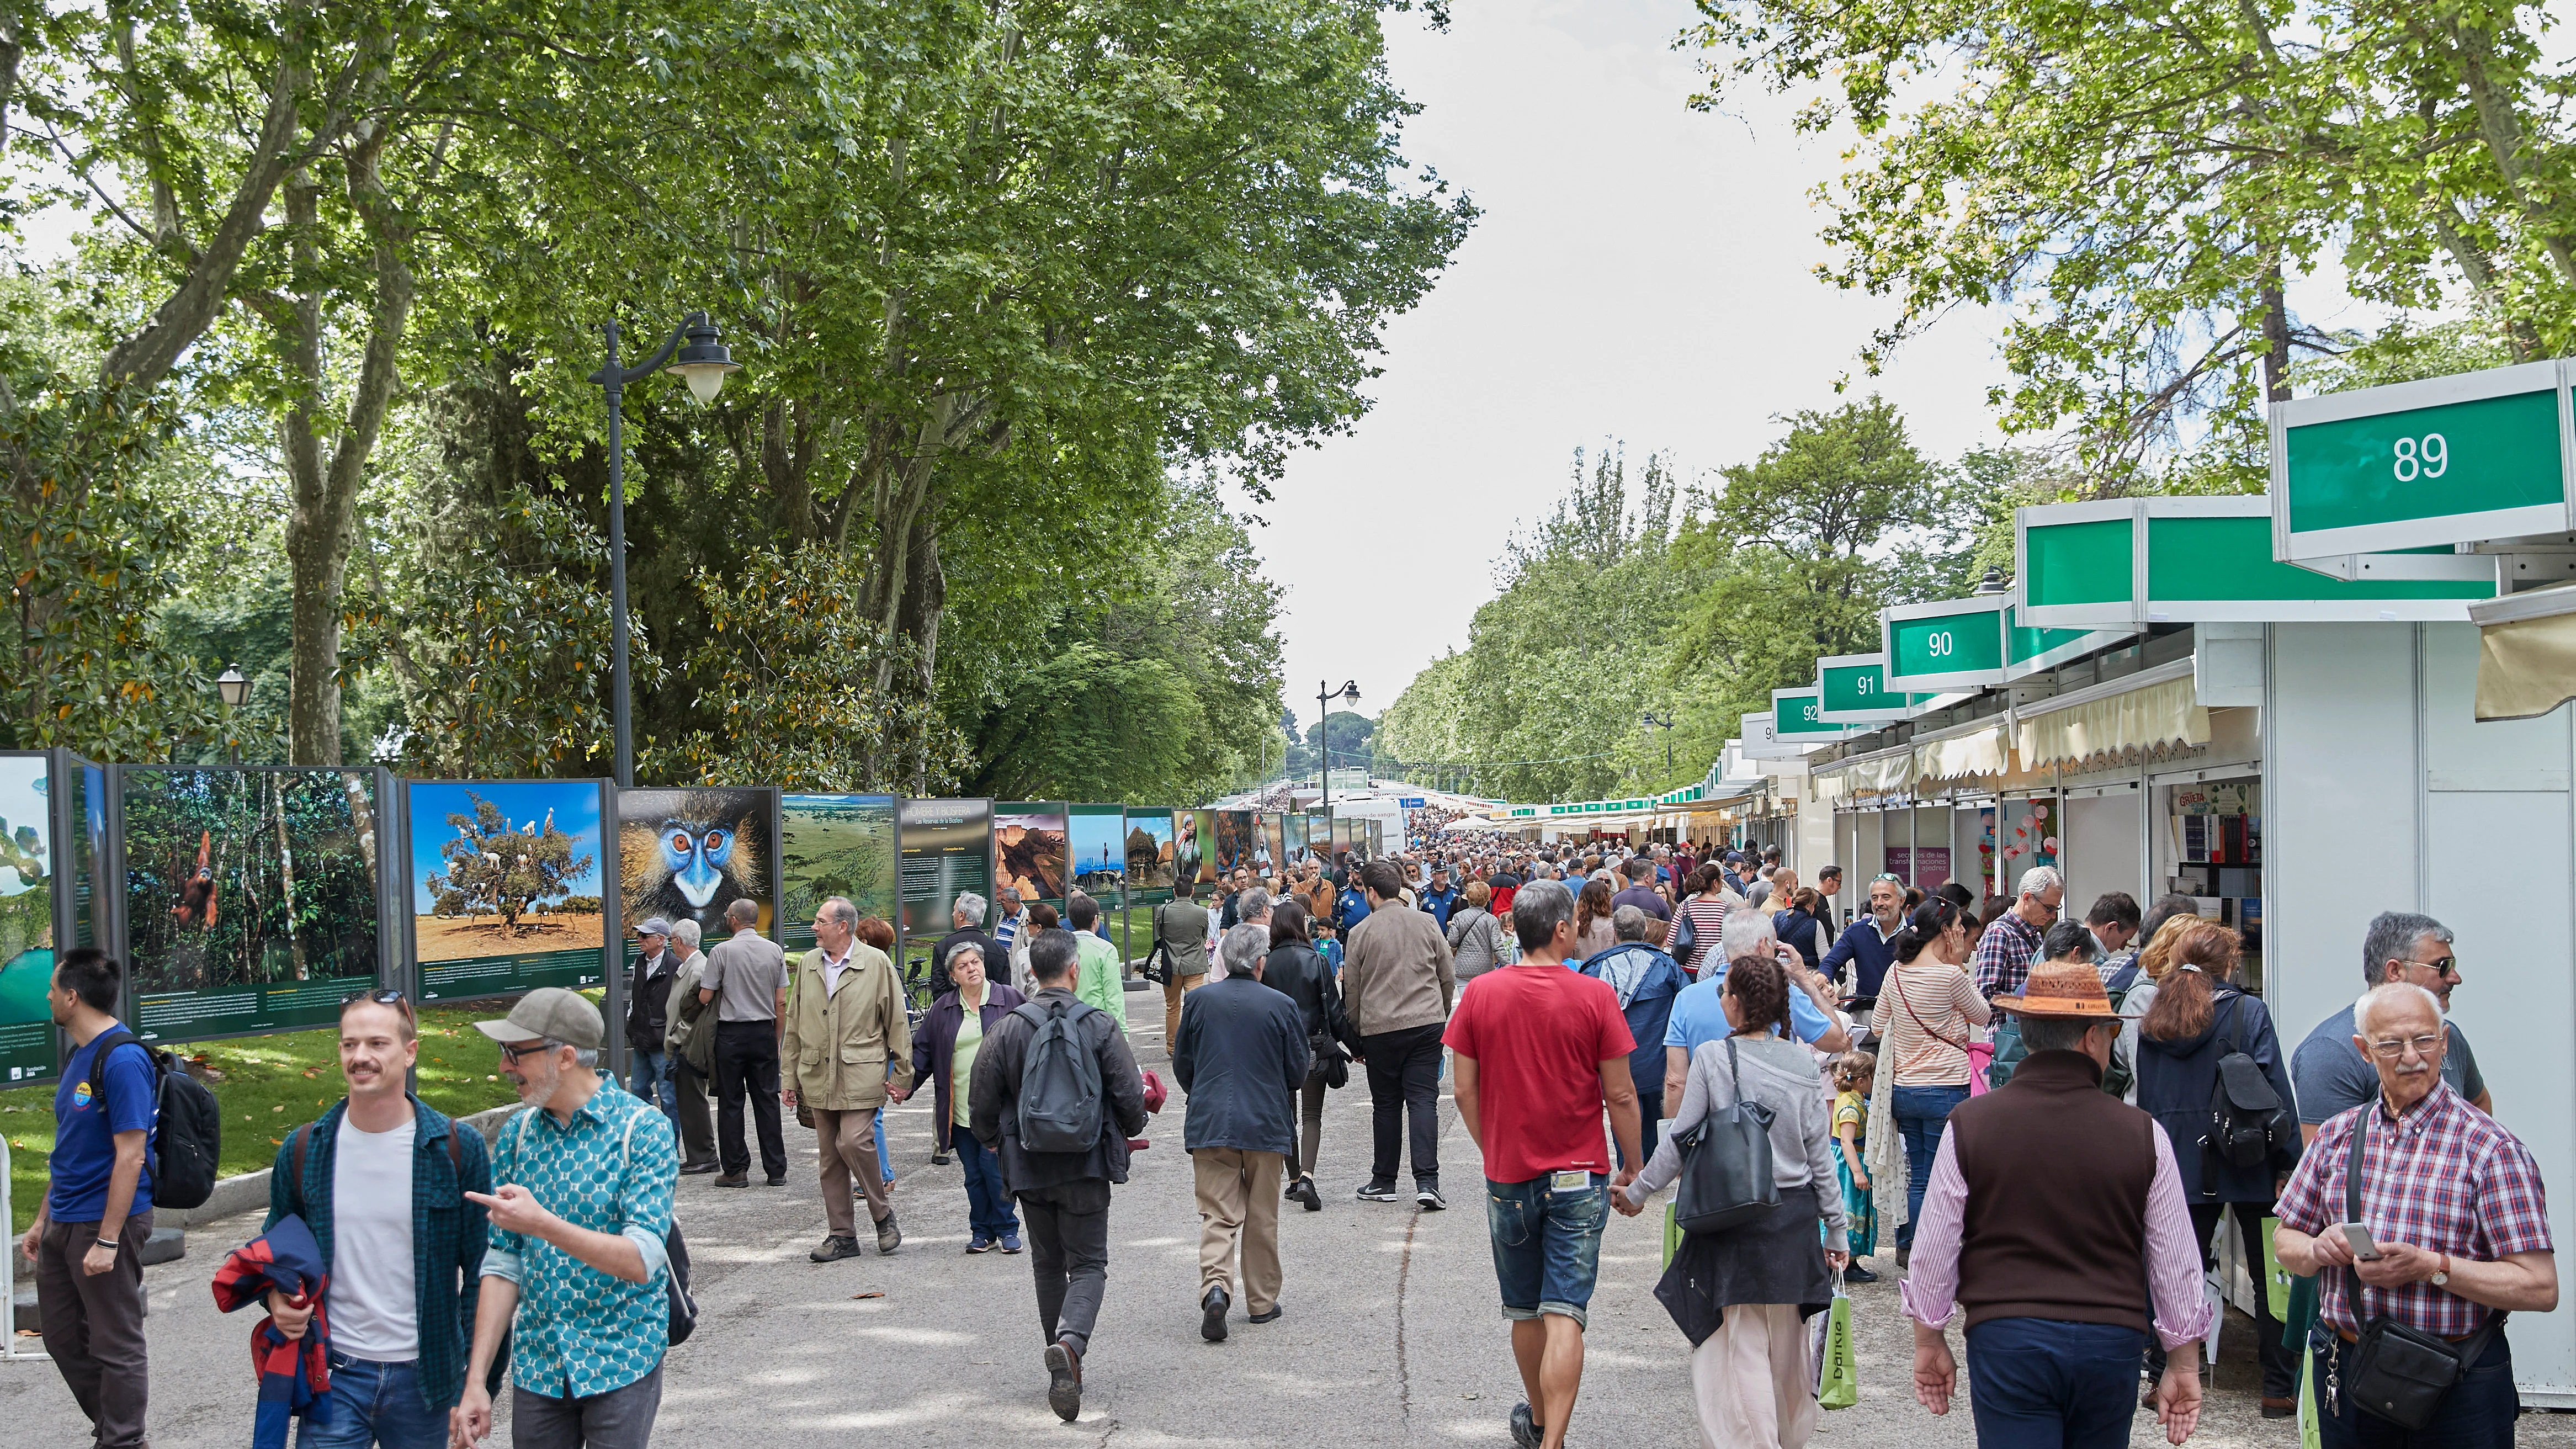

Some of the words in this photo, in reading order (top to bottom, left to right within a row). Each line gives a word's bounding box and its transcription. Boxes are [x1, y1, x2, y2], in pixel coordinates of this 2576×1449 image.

[2393, 433, 2448, 482] 89
[1929, 631, 1952, 657] 90
[1857, 675, 1874, 695] 91
[1803, 705, 1818, 721] 92
[1766, 727, 1773, 740] 9
[2180, 793, 2205, 807] GRIETA
[906, 806, 934, 816] HOMBRE
[935, 806, 940, 816] Y
[941, 806, 971, 816] BIOSFERA
